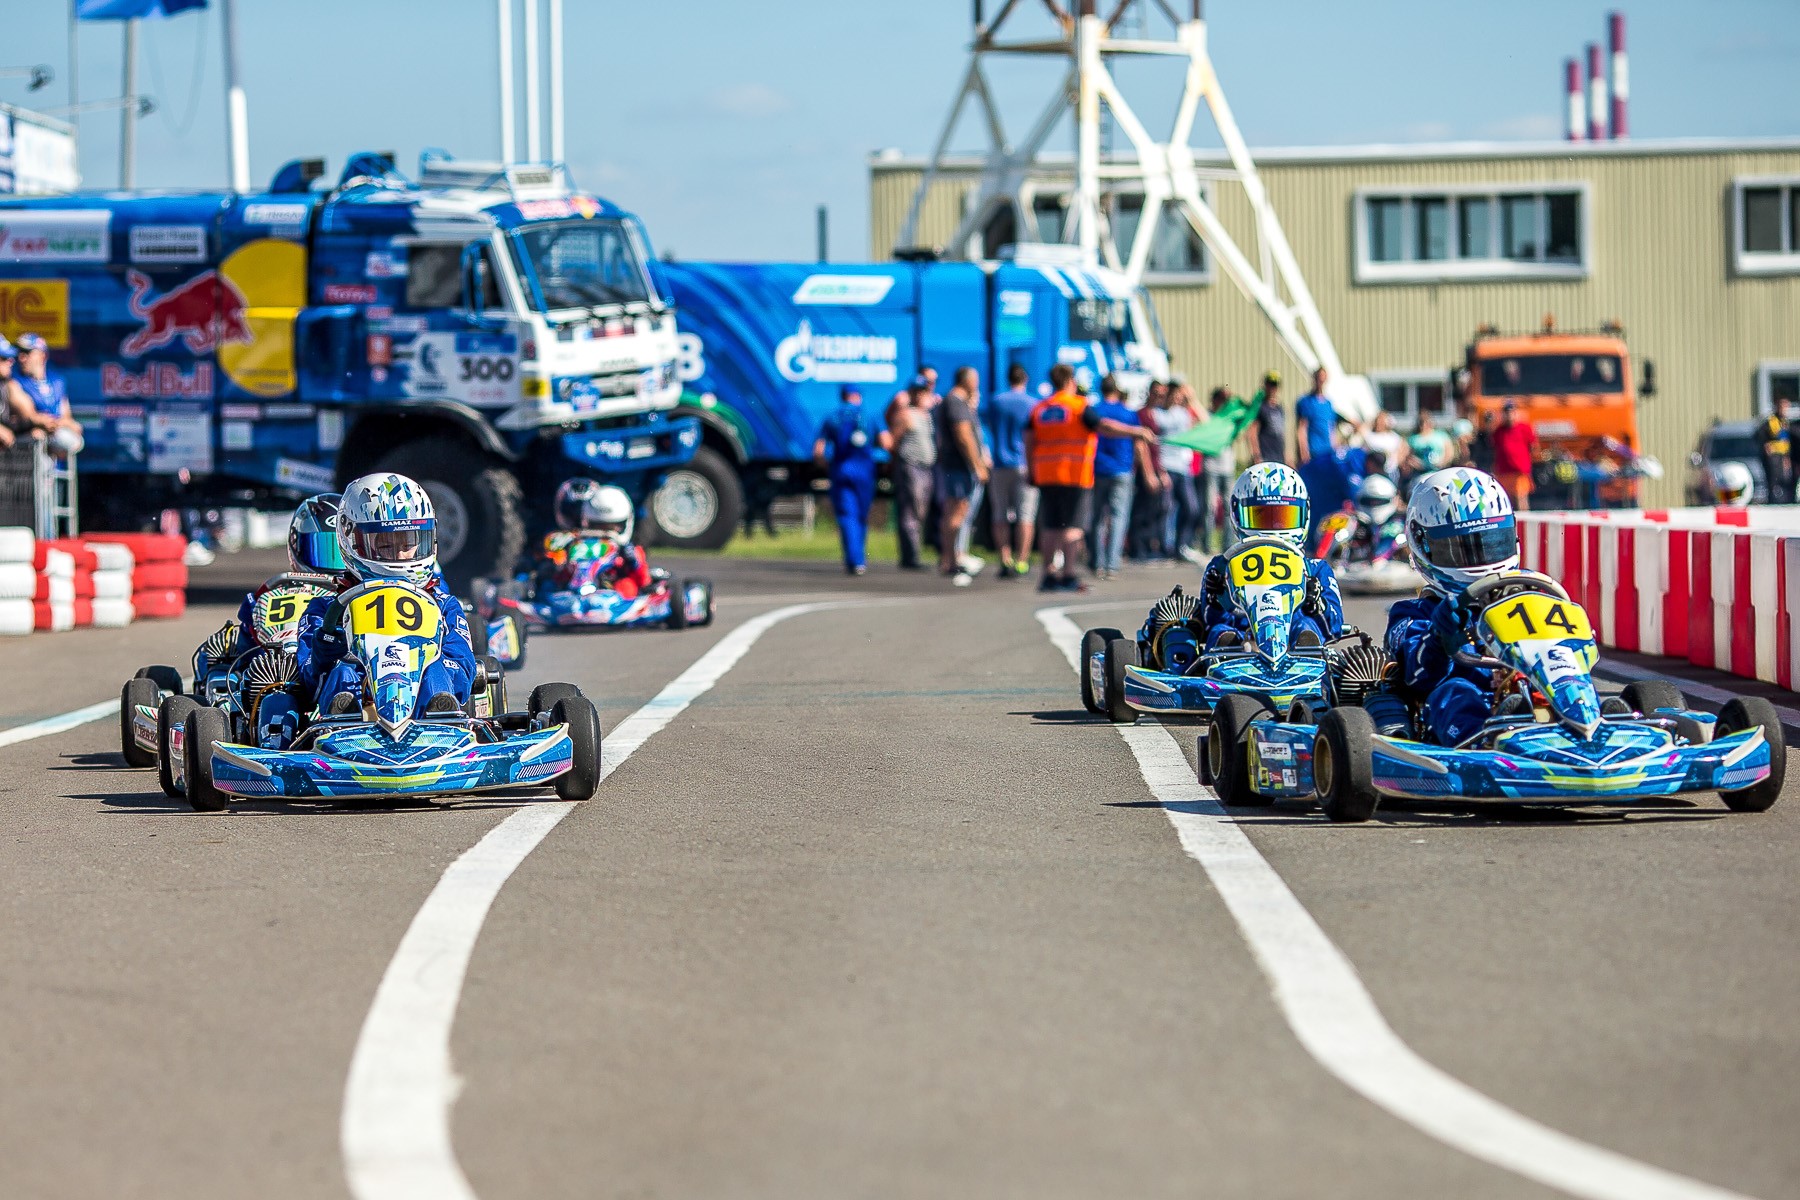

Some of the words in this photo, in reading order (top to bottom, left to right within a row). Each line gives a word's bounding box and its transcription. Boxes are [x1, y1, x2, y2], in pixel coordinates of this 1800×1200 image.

[102, 362, 156, 396] Red
[160, 361, 213, 396] Bull
[459, 357, 514, 382] 300
[1454, 518, 1488, 529] KAMAZ
[1241, 552, 1292, 582] 95
[365, 594, 423, 631] 19
[1506, 602, 1578, 635] 14
